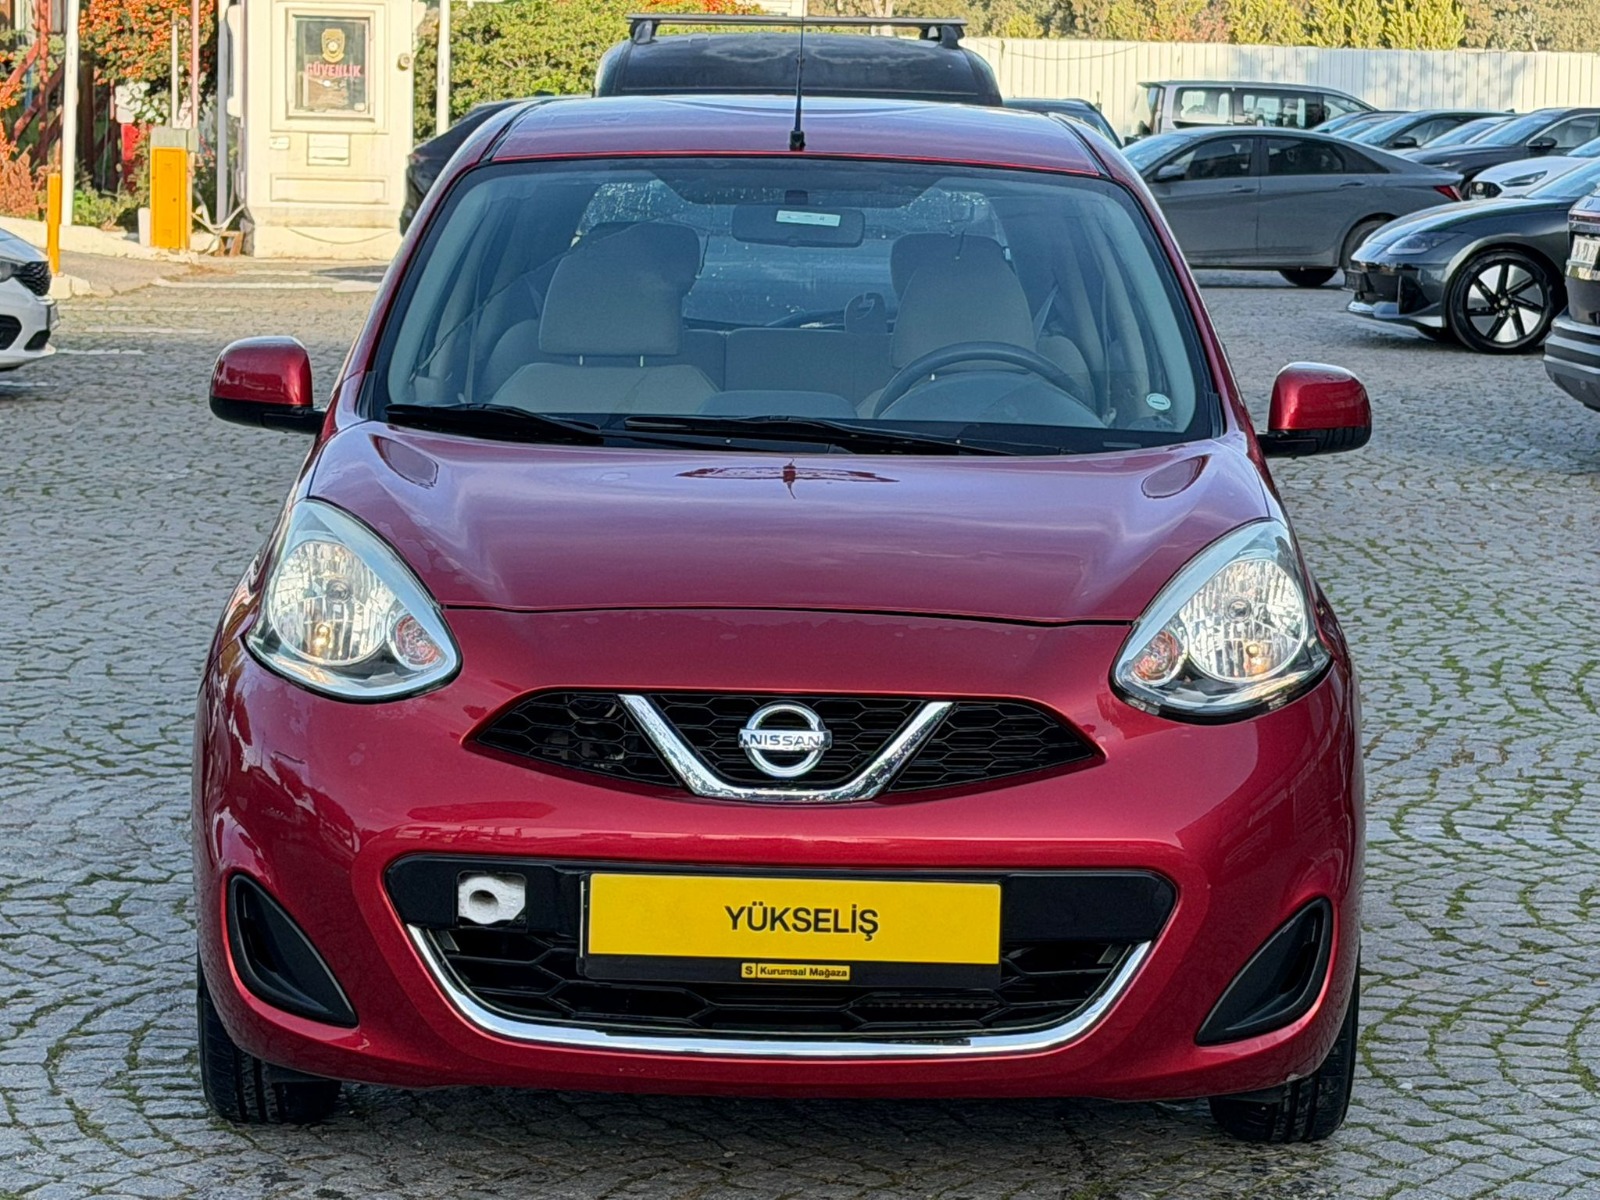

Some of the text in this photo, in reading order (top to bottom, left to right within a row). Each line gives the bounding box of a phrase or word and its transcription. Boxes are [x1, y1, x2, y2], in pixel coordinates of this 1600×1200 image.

[749, 733, 821, 747] NISSAN
[724, 900, 879, 942] YÜKSELİŞ
[744, 965, 848, 979] S Kurumsal Mağaza
